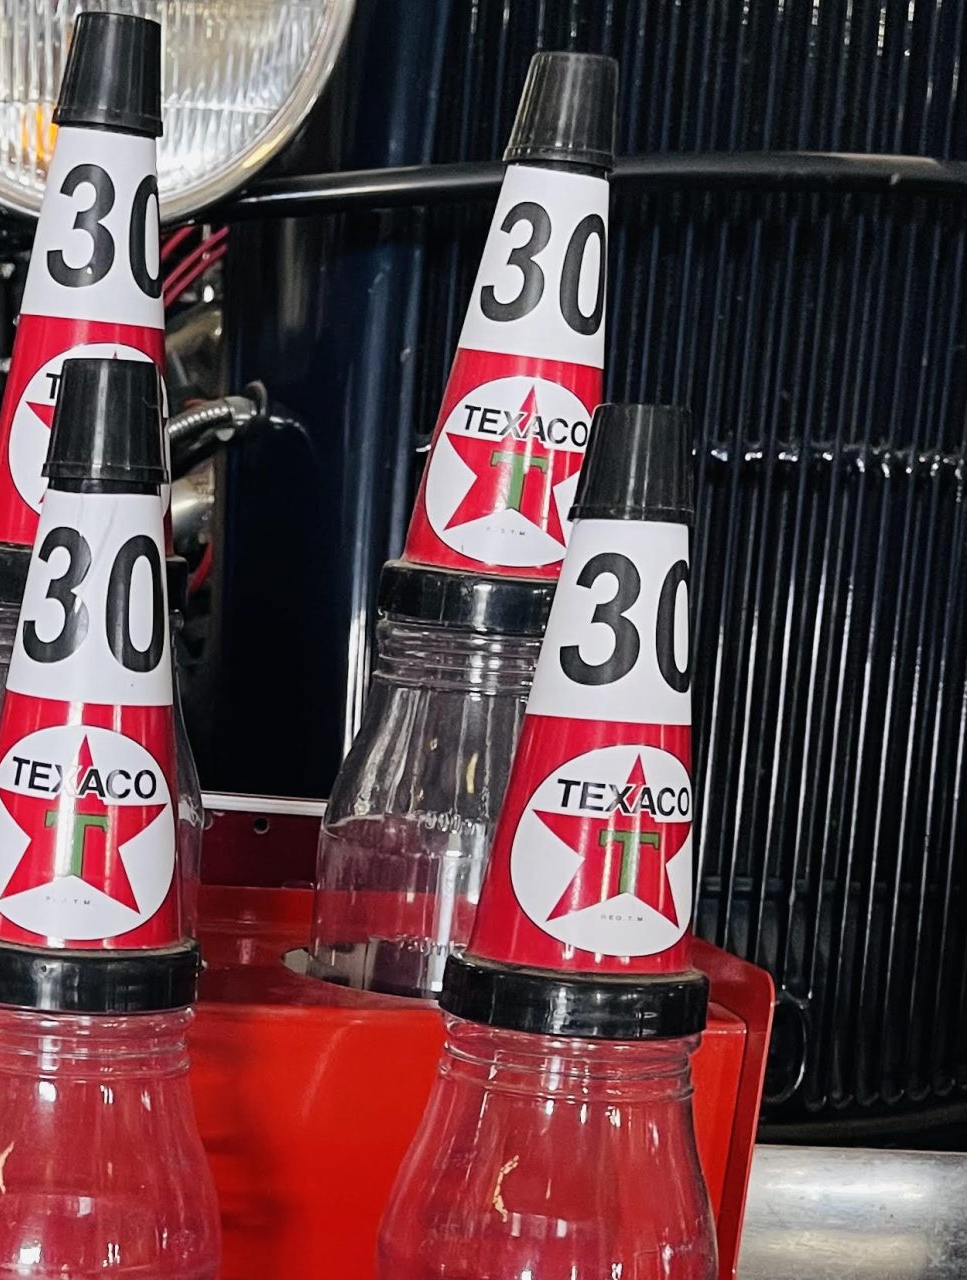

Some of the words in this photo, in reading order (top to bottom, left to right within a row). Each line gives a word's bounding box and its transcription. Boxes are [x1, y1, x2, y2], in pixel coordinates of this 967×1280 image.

[46, 163, 163, 299] 30
[480, 202, 607, 336] 30
[463, 403, 589, 448] TEXACO
[22, 526, 166, 673] 30
[559, 552, 691, 694] 30
[12, 756, 158, 800] TEXACO
[557, 777, 690, 818] TEXACO
